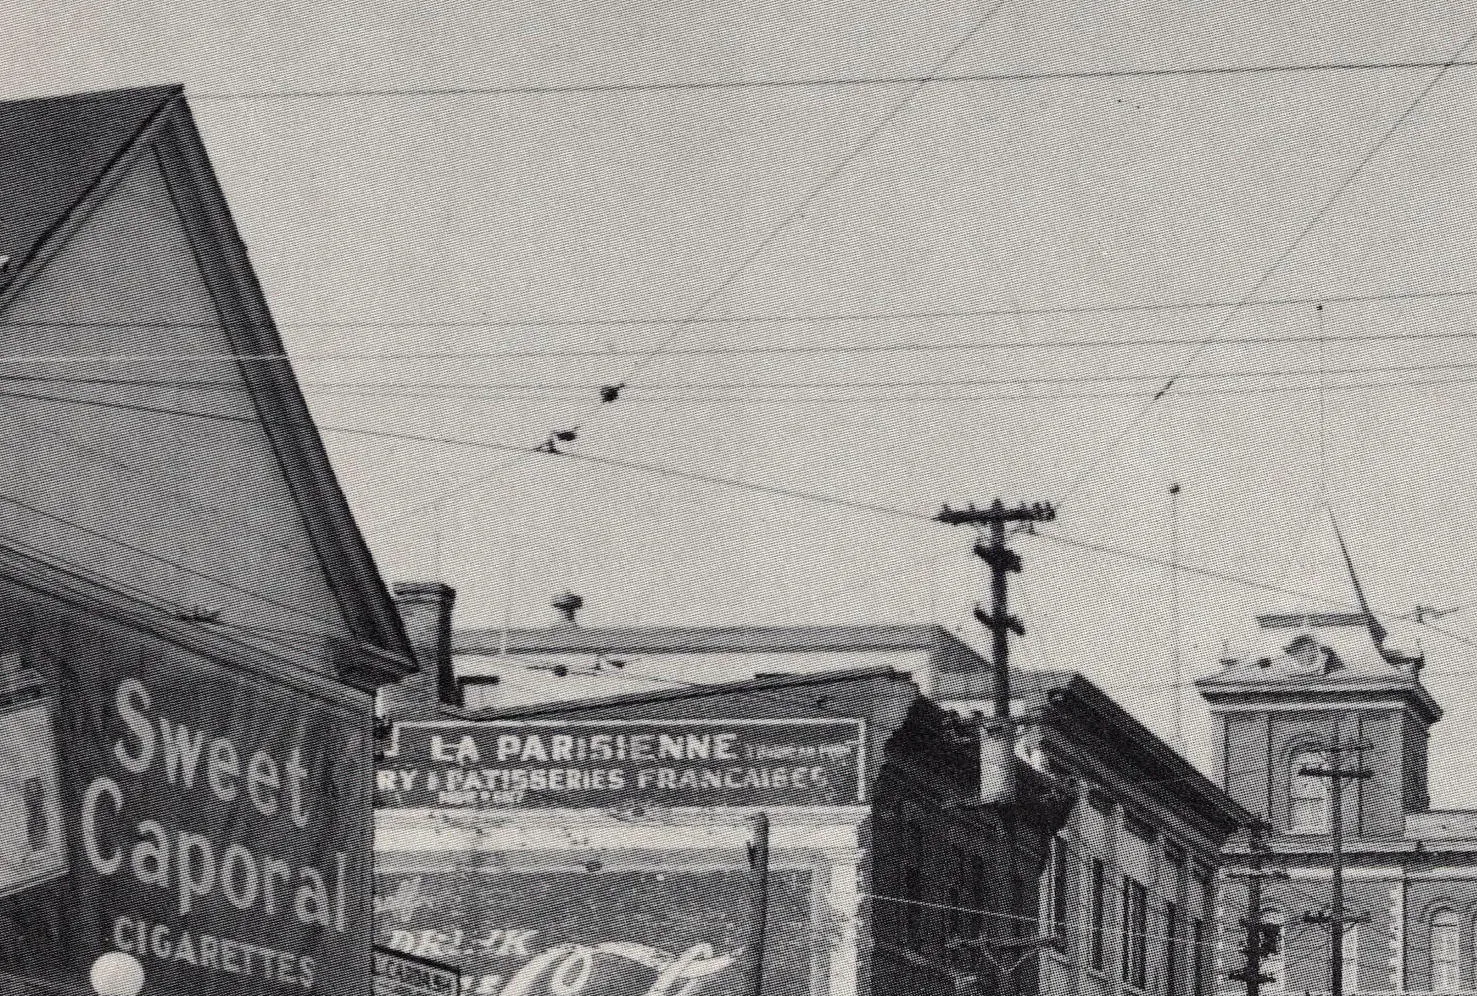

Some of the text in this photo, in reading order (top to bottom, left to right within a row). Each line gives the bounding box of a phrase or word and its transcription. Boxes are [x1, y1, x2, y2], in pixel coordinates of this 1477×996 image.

[113, 678, 309, 828] Sweet
[430, 734, 480, 764] LA
[495, 732, 738, 762] PARISIENNE
[446, 768, 627, 791] PATISSERIES
[81, 776, 347, 933] Caporal
[113, 915, 315, 988] CIGARETTES
